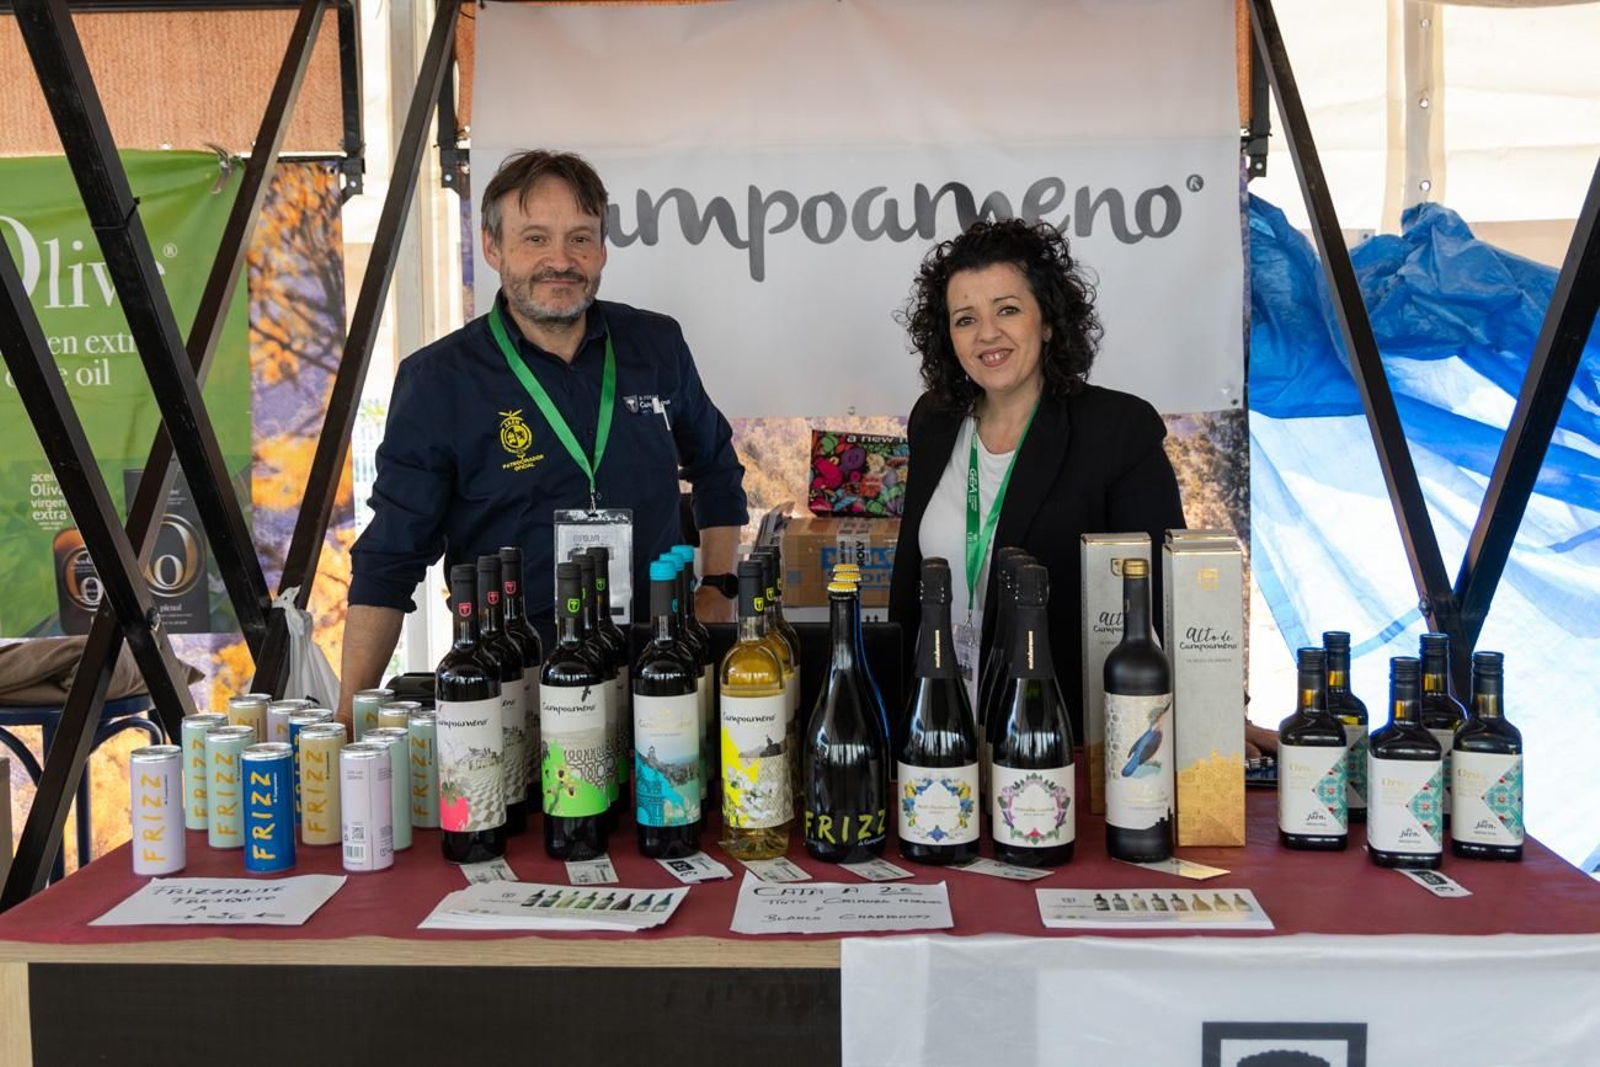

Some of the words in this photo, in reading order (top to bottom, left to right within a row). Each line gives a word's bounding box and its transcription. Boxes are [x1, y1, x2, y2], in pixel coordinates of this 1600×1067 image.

[860, 436, 895, 444] new
[32, 509, 67, 521] extra
[140, 772, 166, 862] FRIZZ
[215, 750, 238, 837] FRIZZ
[250, 770, 276, 860] FRIZZ
[305, 749, 327, 833] FRIZZ
[805, 809, 886, 844] FRIZZ
[753, 886, 824, 896] CATA
[841, 886, 859, 894] A
